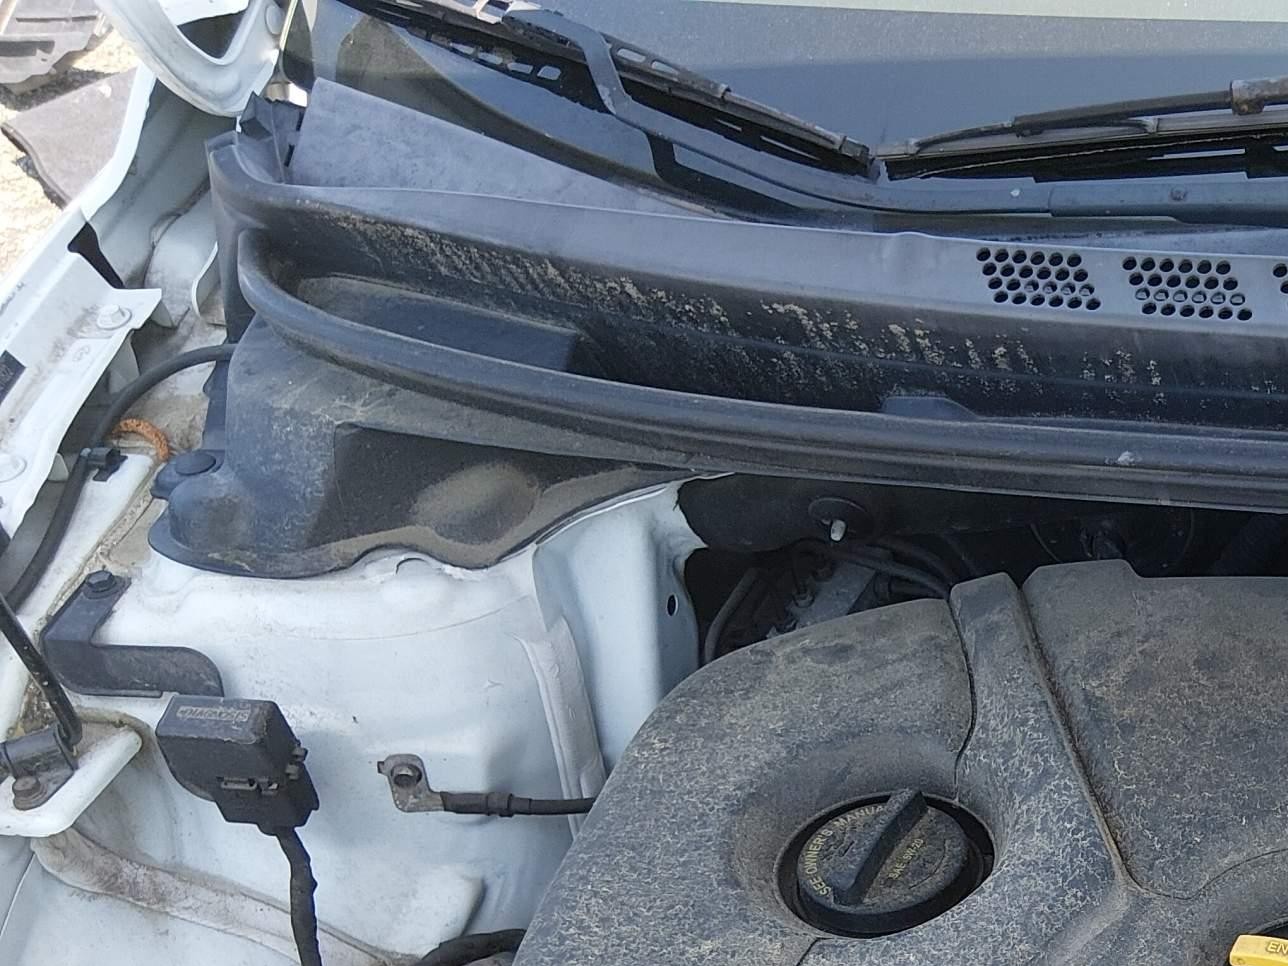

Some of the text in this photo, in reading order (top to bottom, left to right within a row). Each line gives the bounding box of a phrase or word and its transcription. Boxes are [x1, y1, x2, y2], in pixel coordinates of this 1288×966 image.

[804, 805, 884, 896] SEE OWNER'S MANUA
